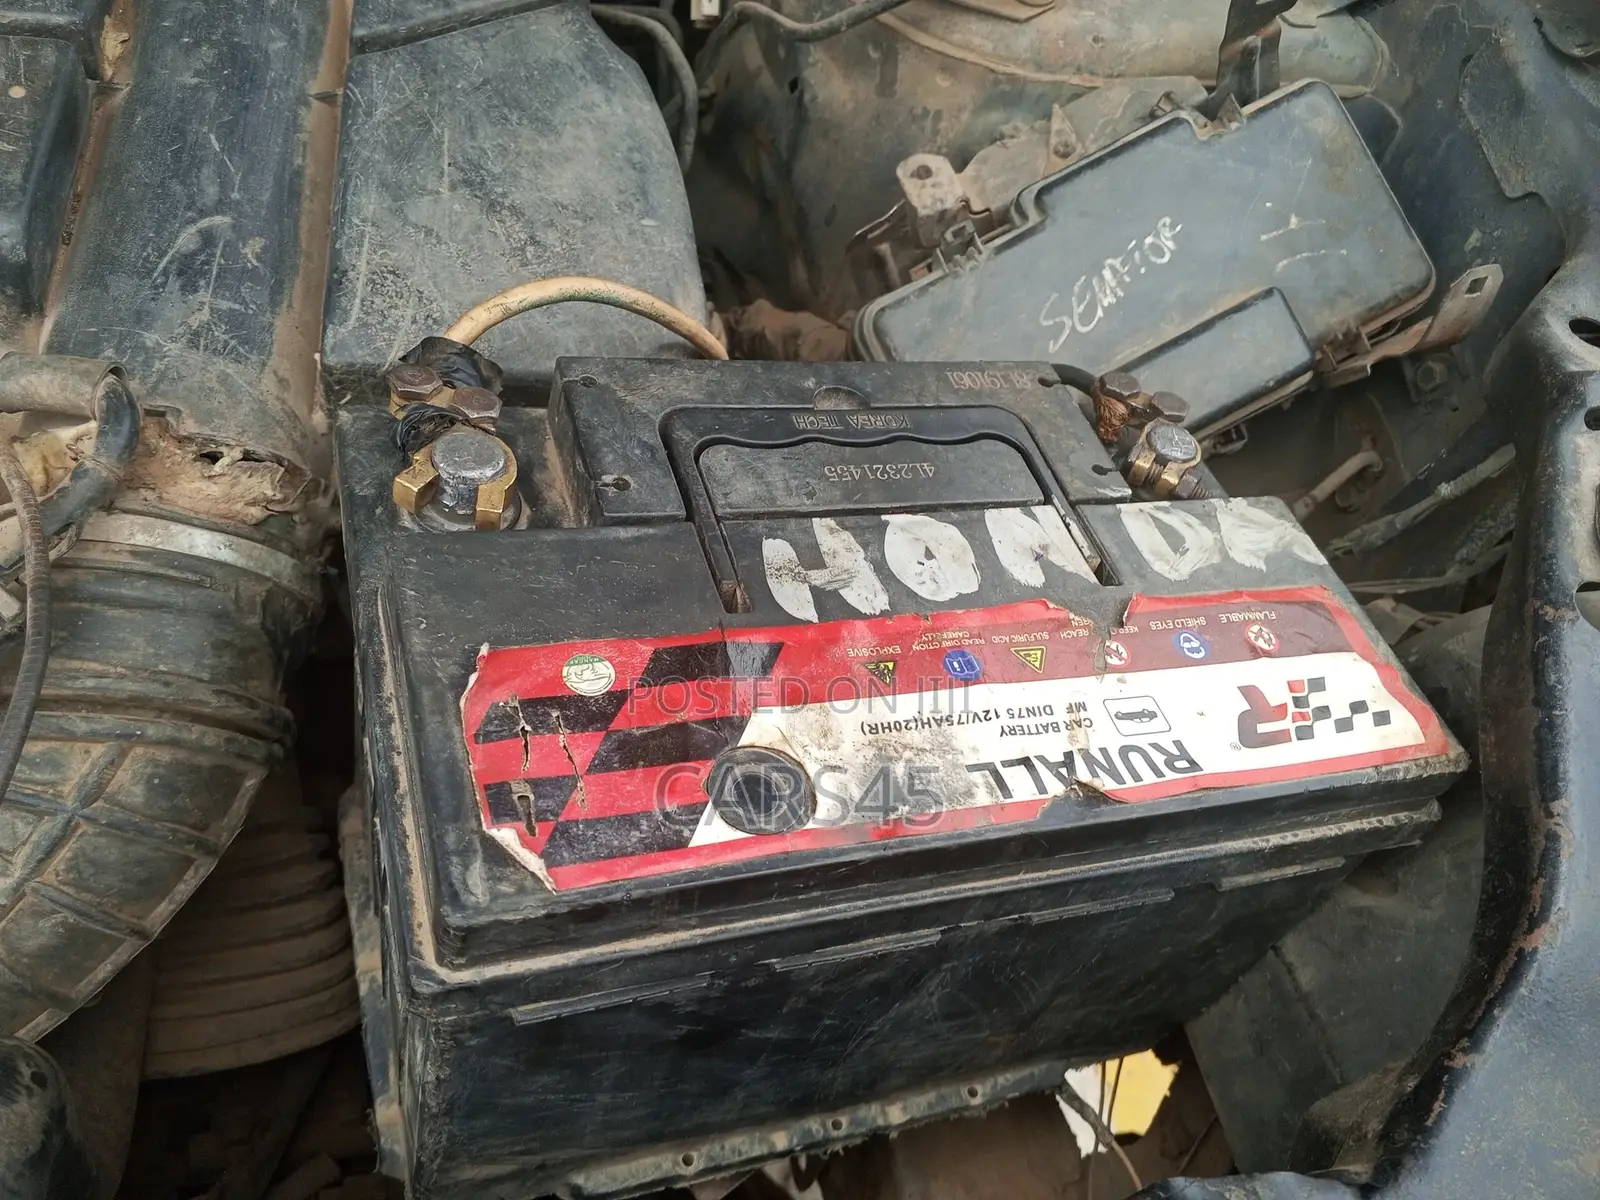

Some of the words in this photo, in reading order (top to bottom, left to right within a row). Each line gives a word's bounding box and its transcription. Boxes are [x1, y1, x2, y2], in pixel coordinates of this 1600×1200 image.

[791, 412, 845, 430] TECH
[846, 414, 911, 430] KOREA
[824, 462, 936, 483] 4L2321455
[1171, 615, 1208, 629] SHIELD
[1218, 609, 1277, 625] FLAMMABLE
[1148, 620, 1173, 632] EYES
[991, 634, 1013, 646] ACID
[1009, 630, 1051, 644] SULFURIC
[1059, 627, 1090, 640] REACH
[959, 636, 987, 648] READ
[846, 645, 903, 658] EXPLOSIVE
[1006, 705, 1055, 719] DIN75
[1066, 701, 1088, 714] MF
[999, 720, 1062, 738] BATTERY
[1058, 717, 1094, 733] CAR
[965, 739, 1204, 800] RUNALL
